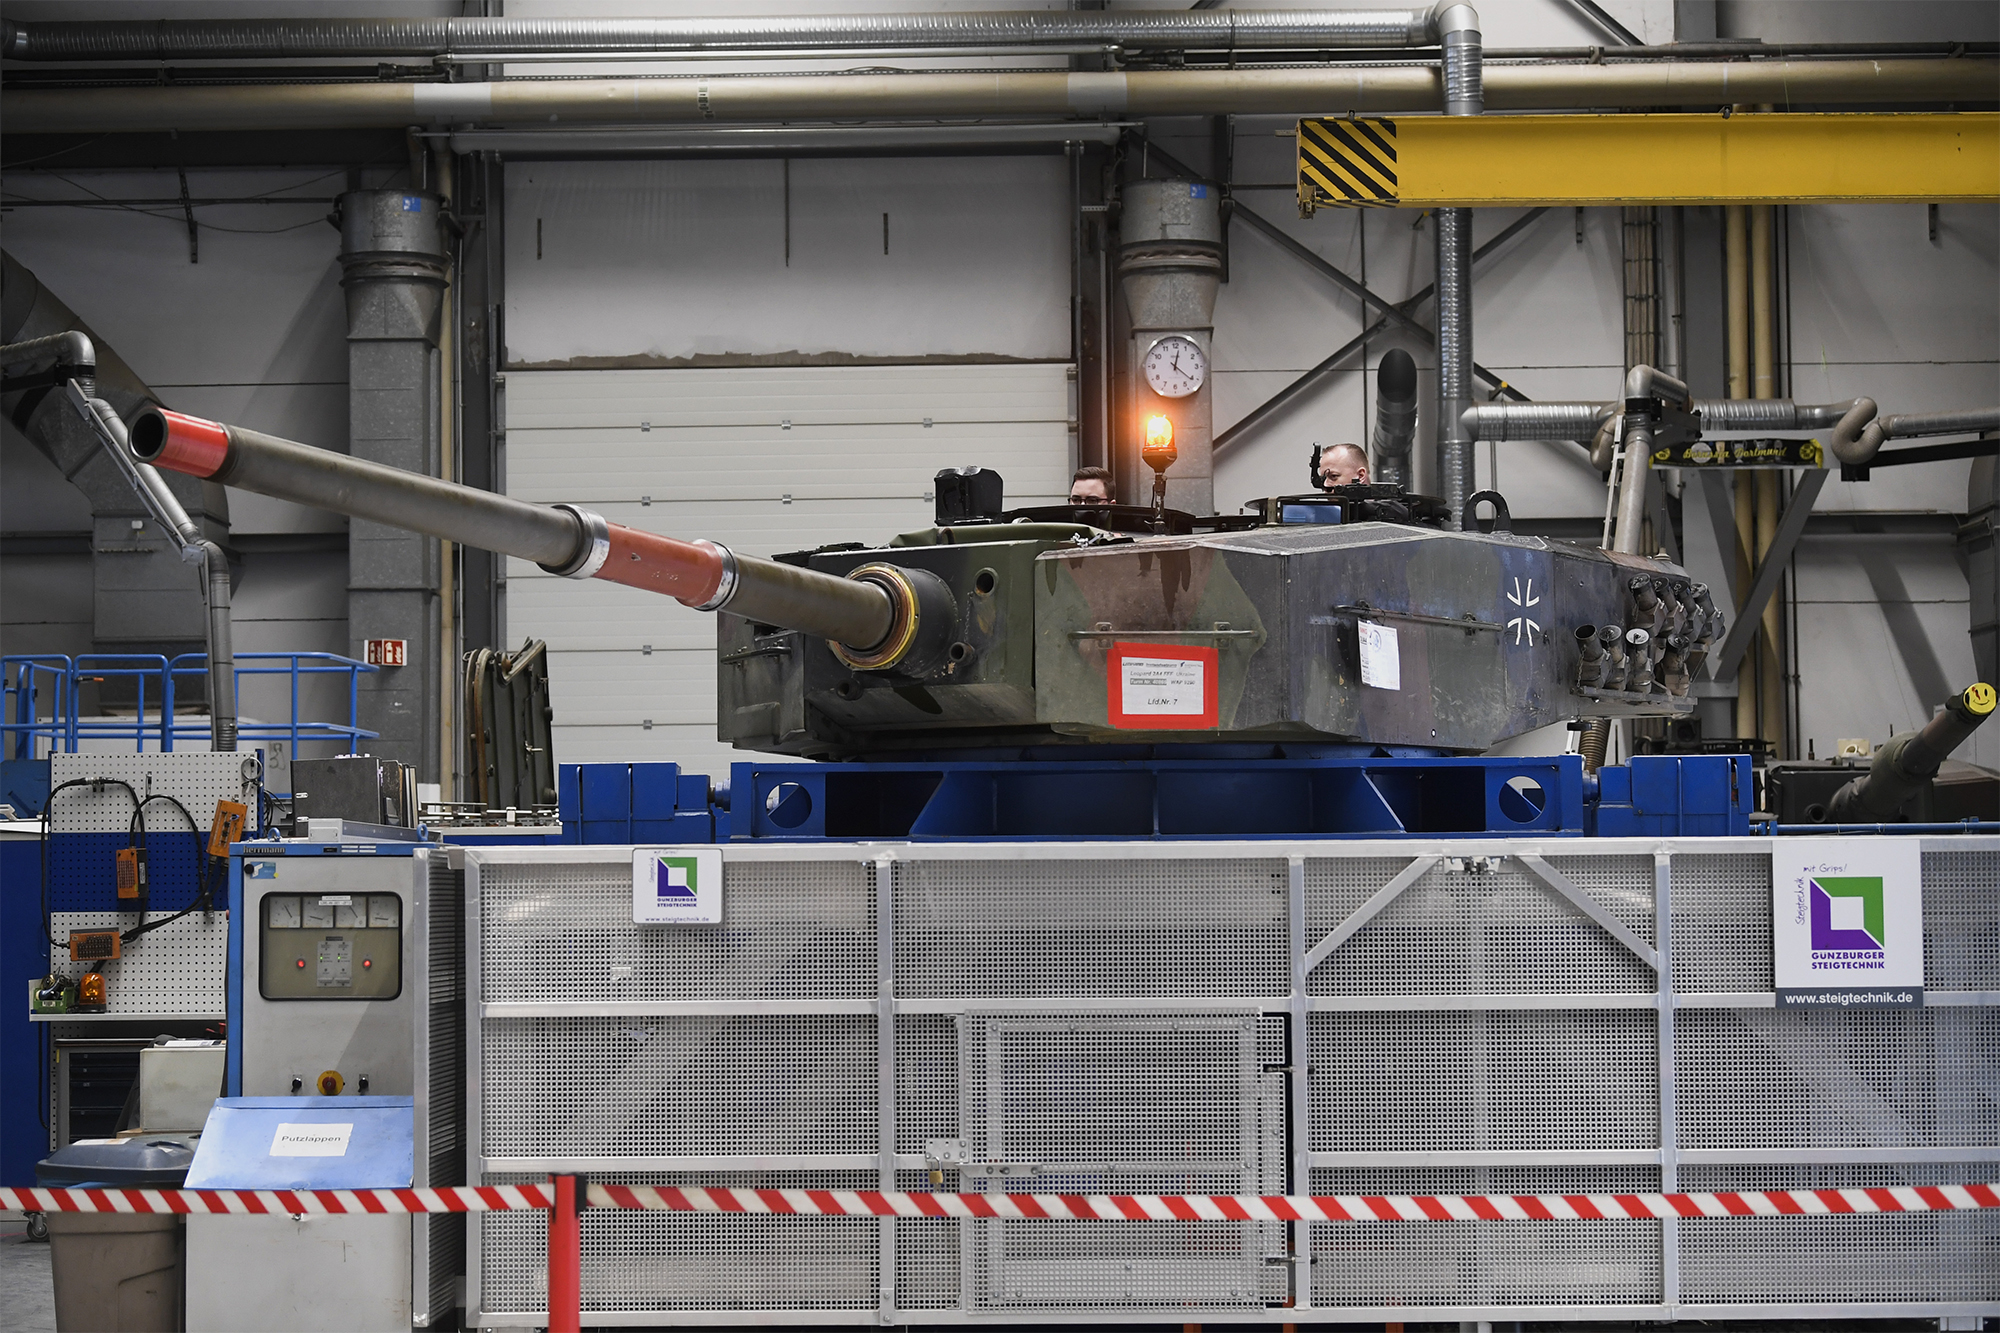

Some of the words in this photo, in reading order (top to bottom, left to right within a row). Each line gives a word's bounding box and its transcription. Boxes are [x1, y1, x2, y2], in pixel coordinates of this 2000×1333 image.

[1682, 448, 1730, 459] Borussia
[1734, 446, 1788, 459] Dortmund
[243, 845, 286, 854] herrmann
[1819, 863, 1848, 874] Grips!
[1794, 876, 1808, 925] Steigtechnik
[1811, 961, 1885, 969] STEIGTECHNIK
[1785, 991, 1914, 1005] www.steigtechnik.de
[281, 1135, 341, 1143] Putzlappen
